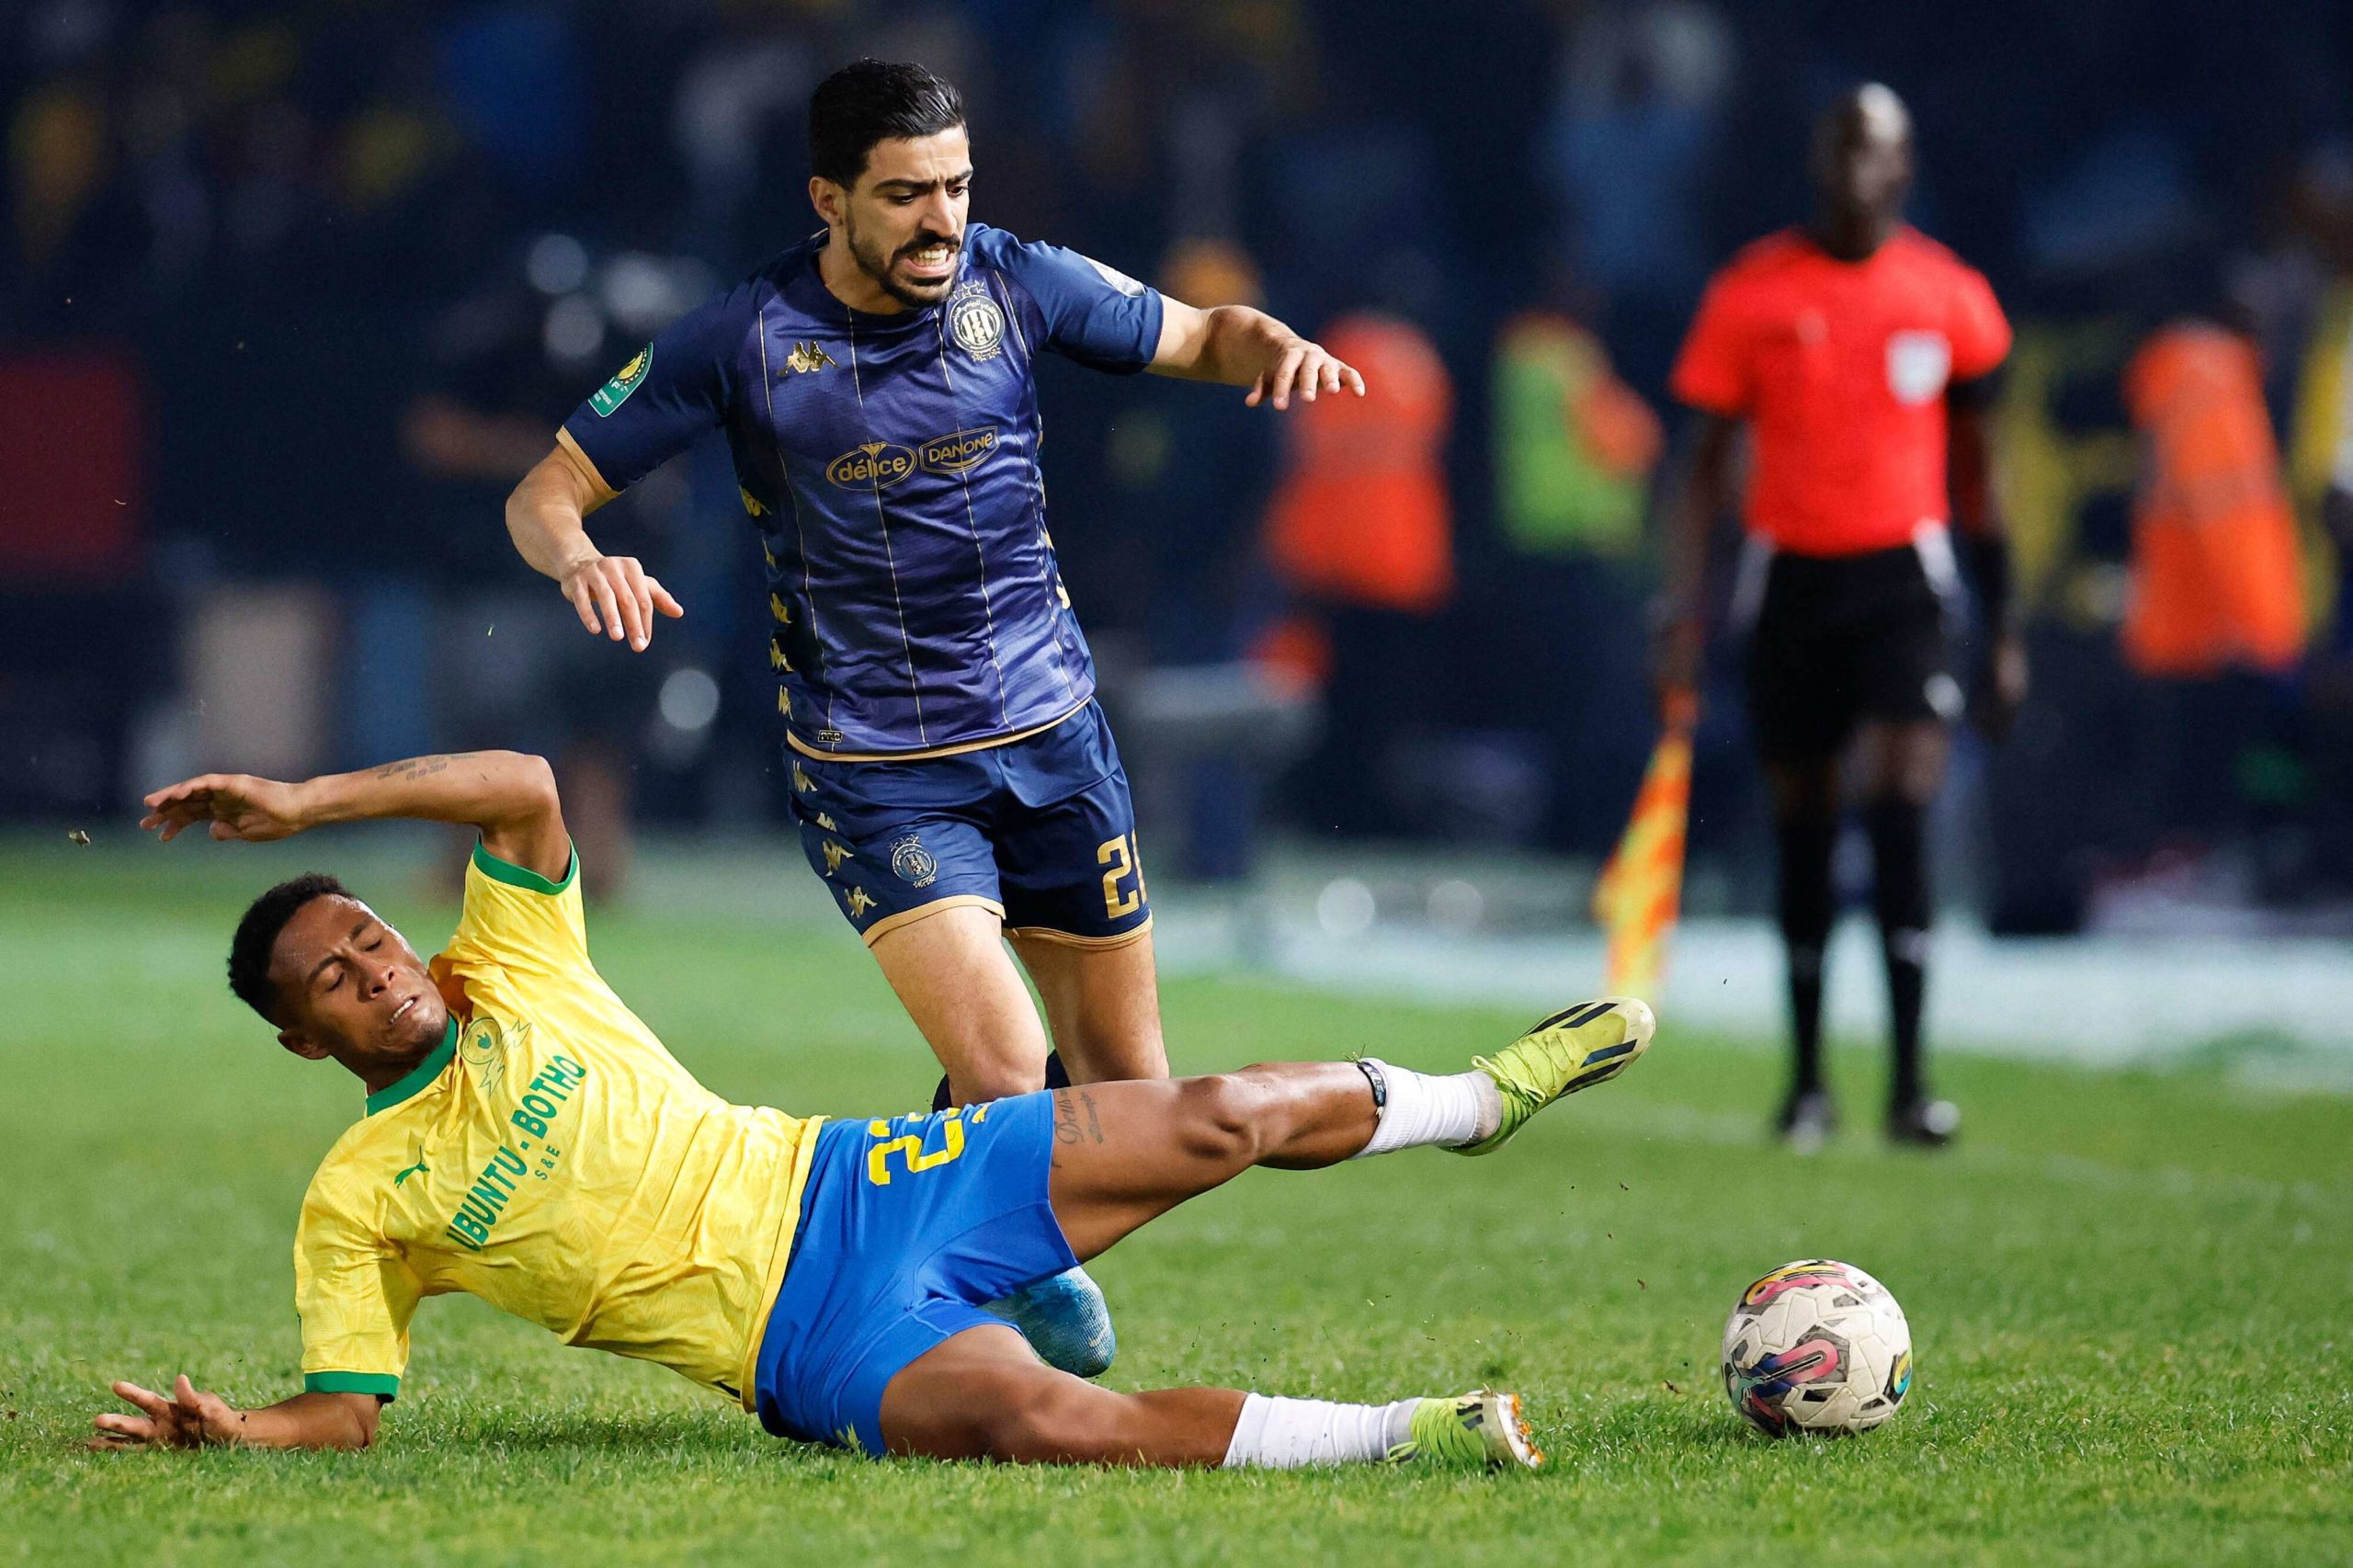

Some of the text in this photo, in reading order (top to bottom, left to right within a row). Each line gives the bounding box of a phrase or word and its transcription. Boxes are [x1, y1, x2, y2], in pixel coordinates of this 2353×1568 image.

[838, 457, 906, 482] délice
[446, 1145, 528, 1252] UBUNTU
[510, 1055, 587, 1140] BOTHO
[534, 1145, 561, 1180] S & E
